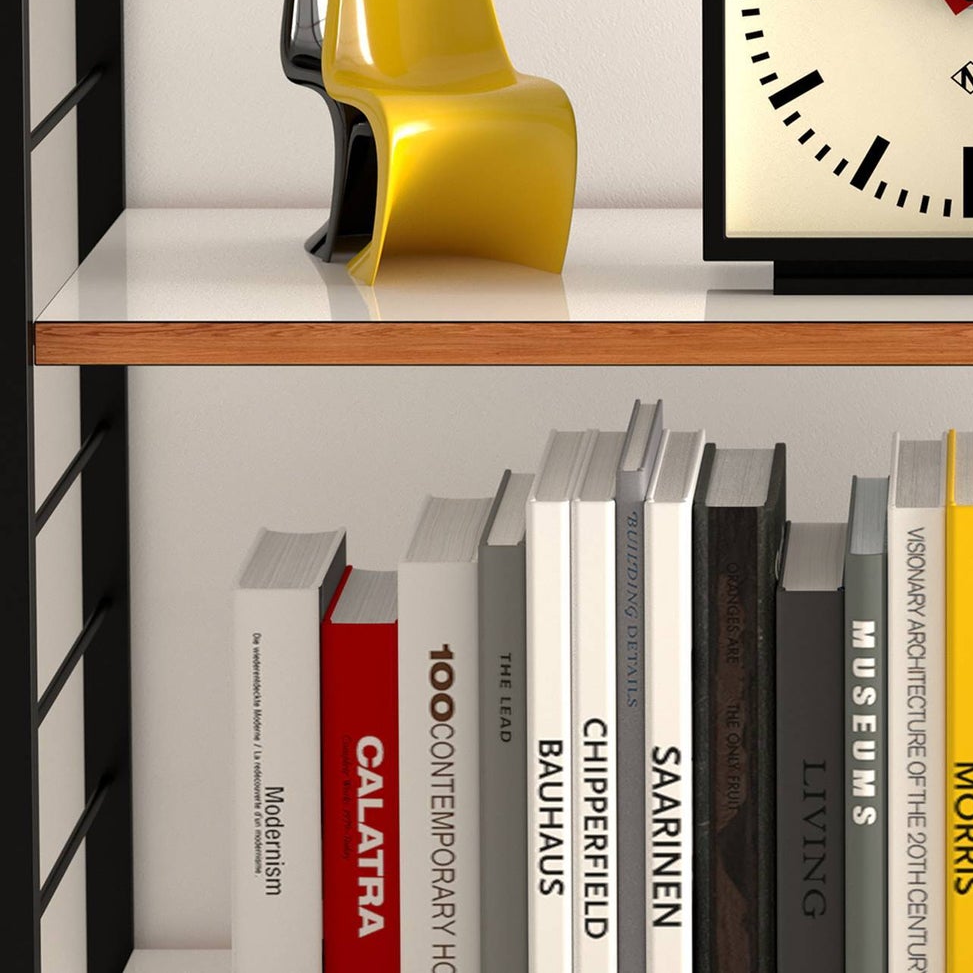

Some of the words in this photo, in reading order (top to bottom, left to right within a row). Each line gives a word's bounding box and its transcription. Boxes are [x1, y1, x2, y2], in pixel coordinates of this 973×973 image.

[625, 511, 639, 619] BUILDING
[906, 527, 927, 617] VISIONARY
[500, 652, 512, 689] THE
[627, 625, 638, 708] DETAILS
[906, 619, 927, 758] ARCHITECTURE
[253, 709, 263, 741] Moderne
[500, 696, 512, 743] LEAD
[852, 620, 877, 825] MUSEUMS
[538, 739, 564, 896] BAUHAUS
[907, 761, 927, 786] OF
[907, 789, 927, 828] THE
[264, 786, 285, 896] Modernism
[356, 735, 385, 938] CALATRA
[583, 717, 609, 940] CHIPPERFIELD
[651, 746, 682, 927] SAARINEN
[802, 759, 828, 920] LIVING
[907, 831, 928, 885] 20TH
[907, 888, 928, 973] CENTUR
